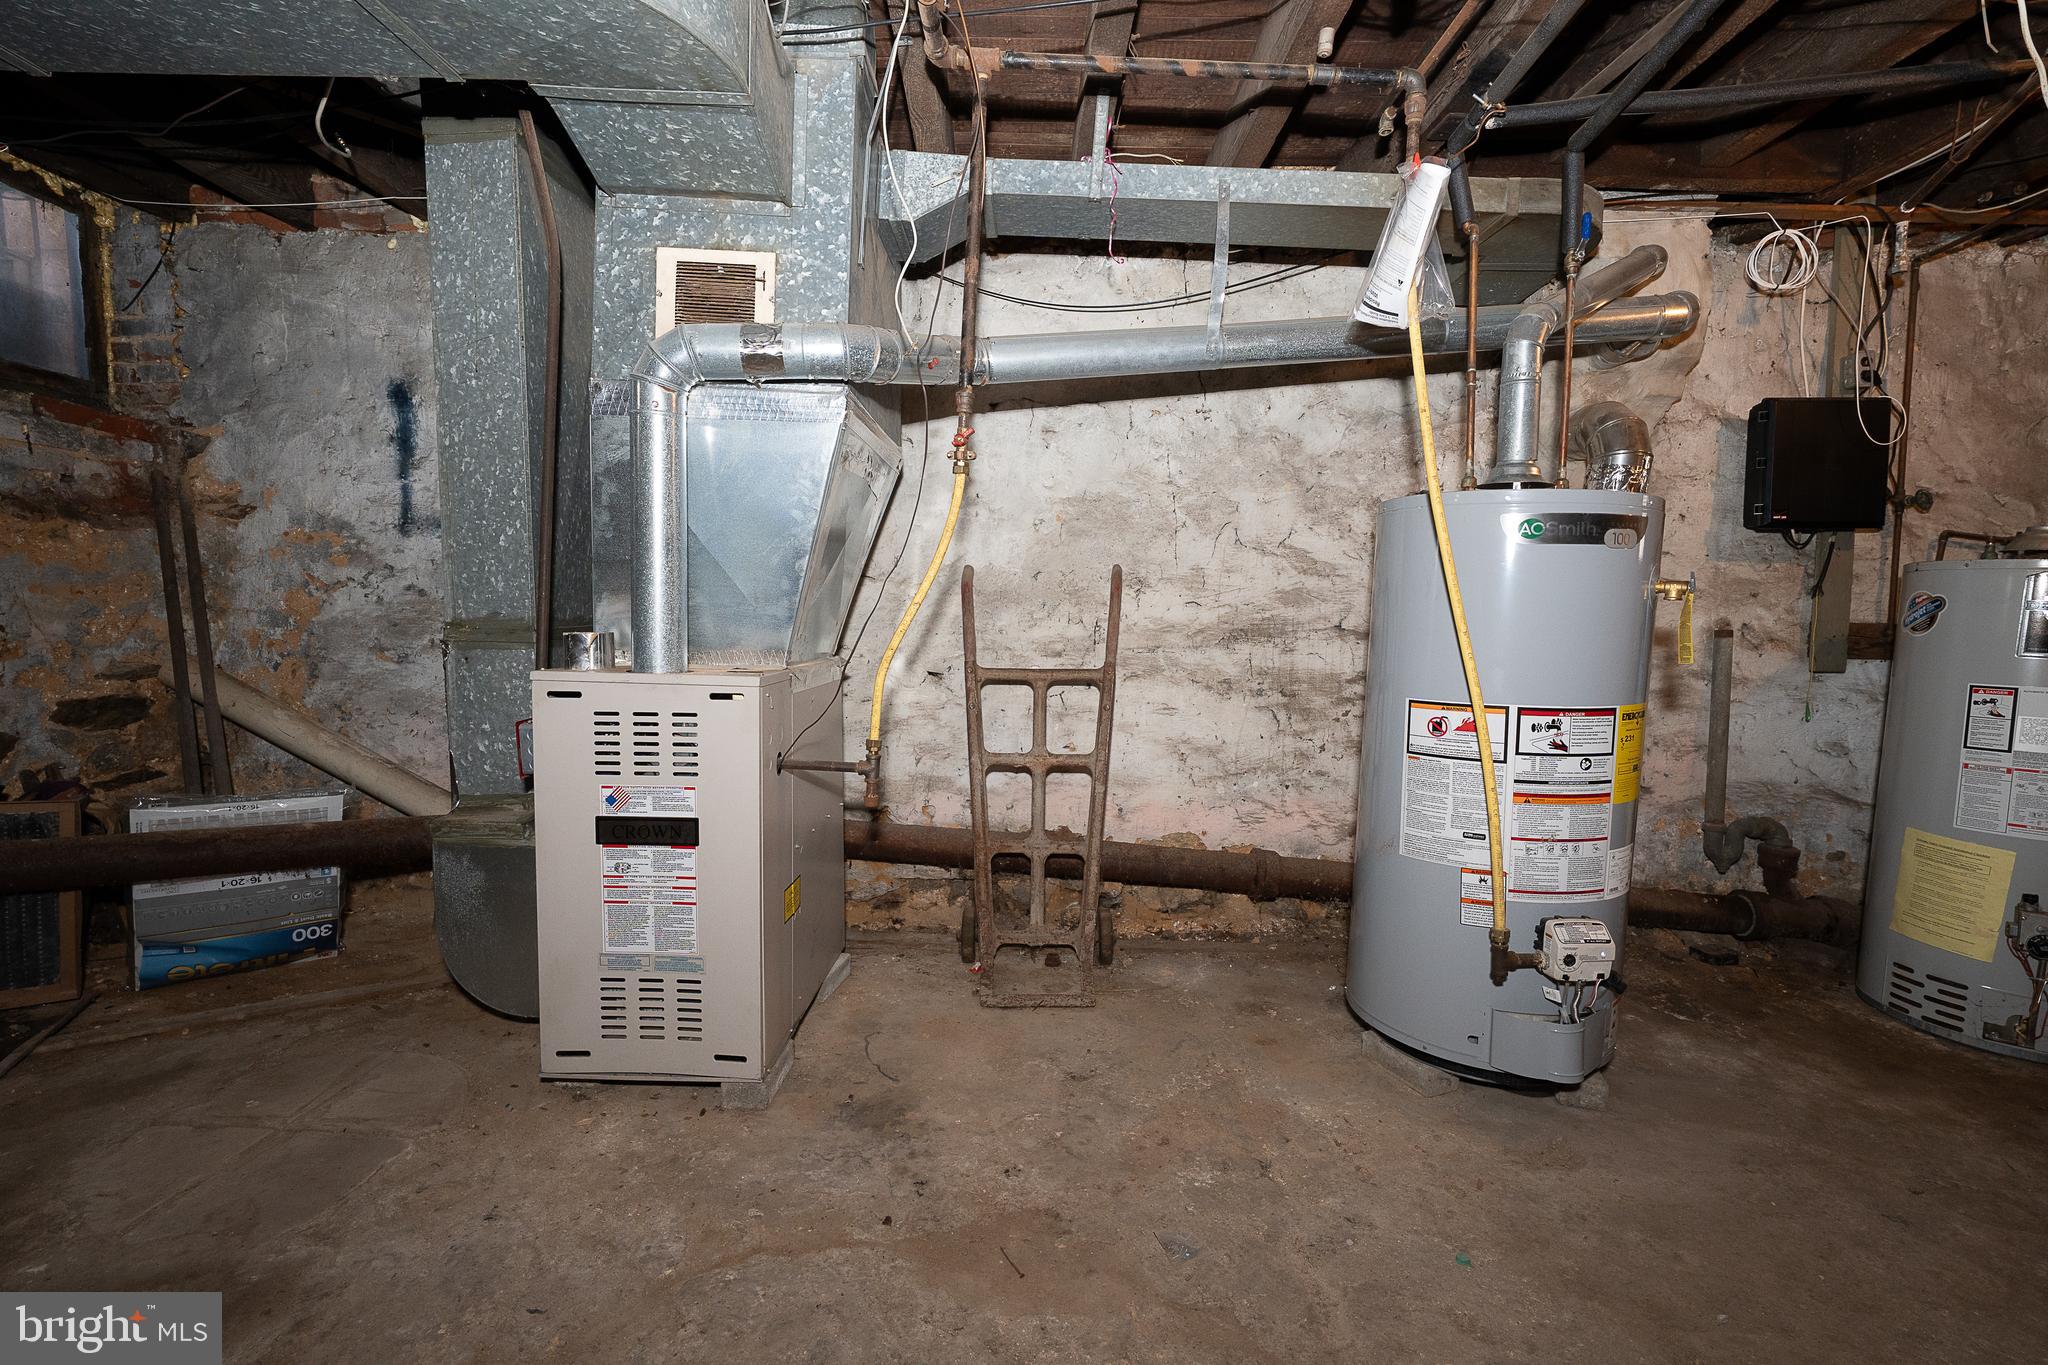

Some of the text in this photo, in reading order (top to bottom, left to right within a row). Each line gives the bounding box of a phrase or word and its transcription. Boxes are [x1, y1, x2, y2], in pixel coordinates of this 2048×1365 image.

[1612, 532, 1630, 546] 100
[612, 825, 682, 839] CROWN
[292, 922, 334, 943] 300
